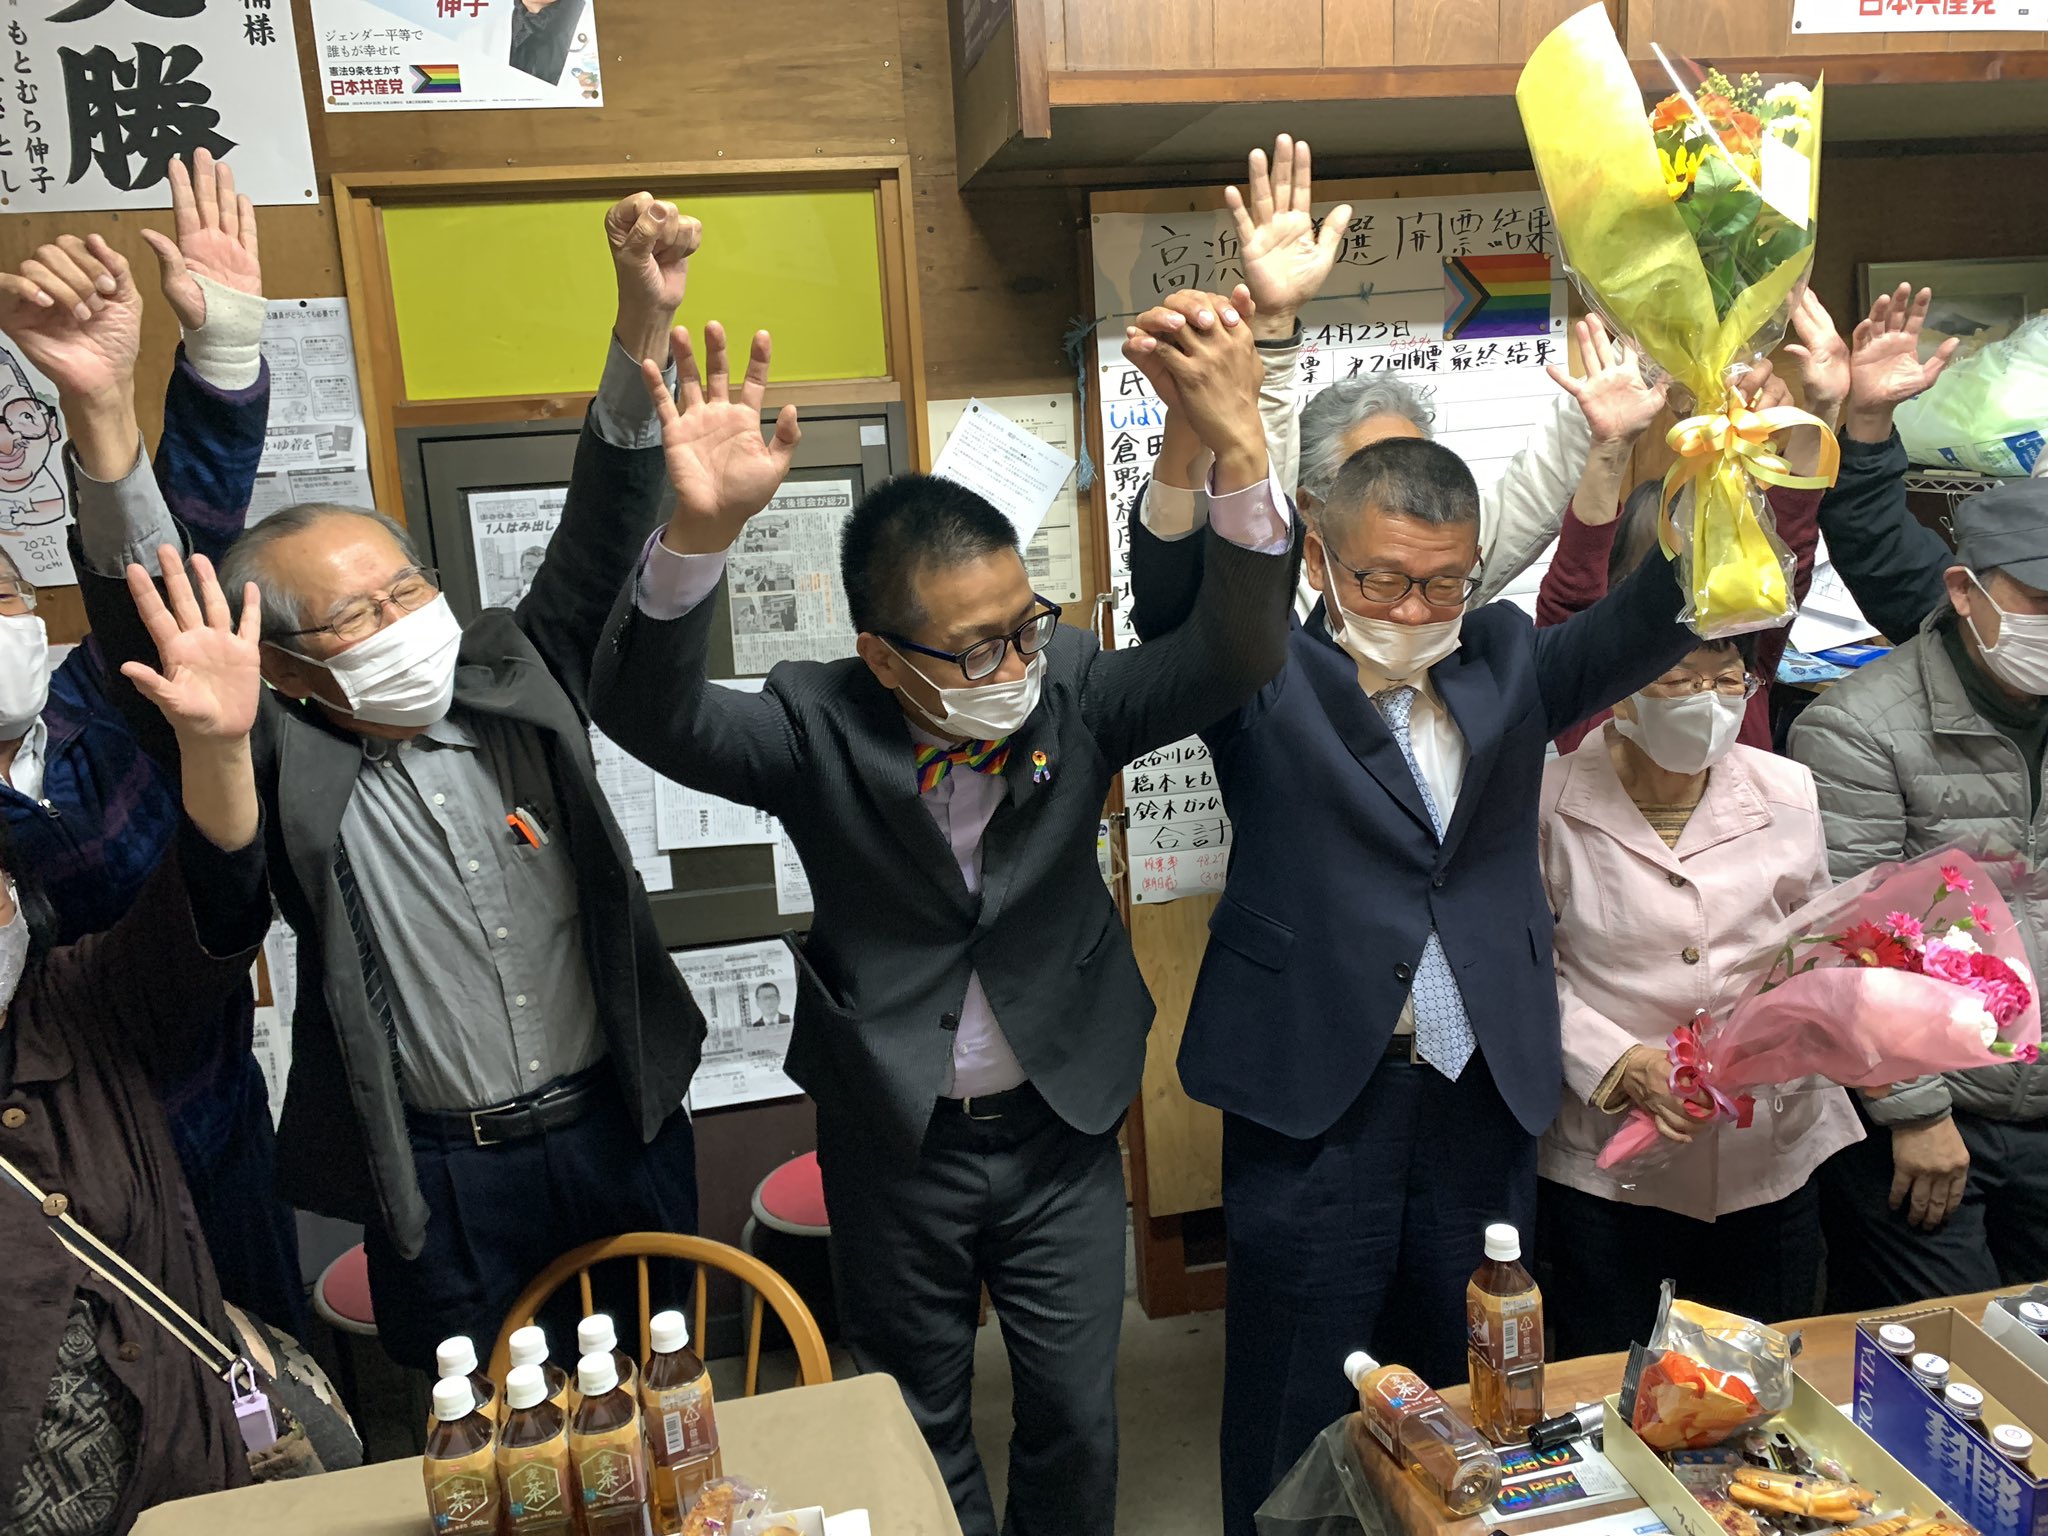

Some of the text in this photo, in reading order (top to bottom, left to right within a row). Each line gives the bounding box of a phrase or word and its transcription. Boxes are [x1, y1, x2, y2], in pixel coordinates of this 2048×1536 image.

[242, 0, 276, 46] 様
[325, 28, 424, 42] ジェンダー平等で
[327, 44, 400, 58] 誰もが幸せに
[329, 66, 401, 77] 憲法9条を生かす
[45, 0, 240, 191] 勝
[330, 79, 405, 96] 日本共産党
[8, 20, 55, 194] もとむら伸子
[1450, 338, 1556, 371] 最終結果
[1120, 370, 1145, 396] 氏
[1300, 356, 1321, 383] 票
[19, 536, 57, 552] 2022
[1150, 818, 1232, 849] 合計
[1858, 1346, 1876, 1430] IOVITA
